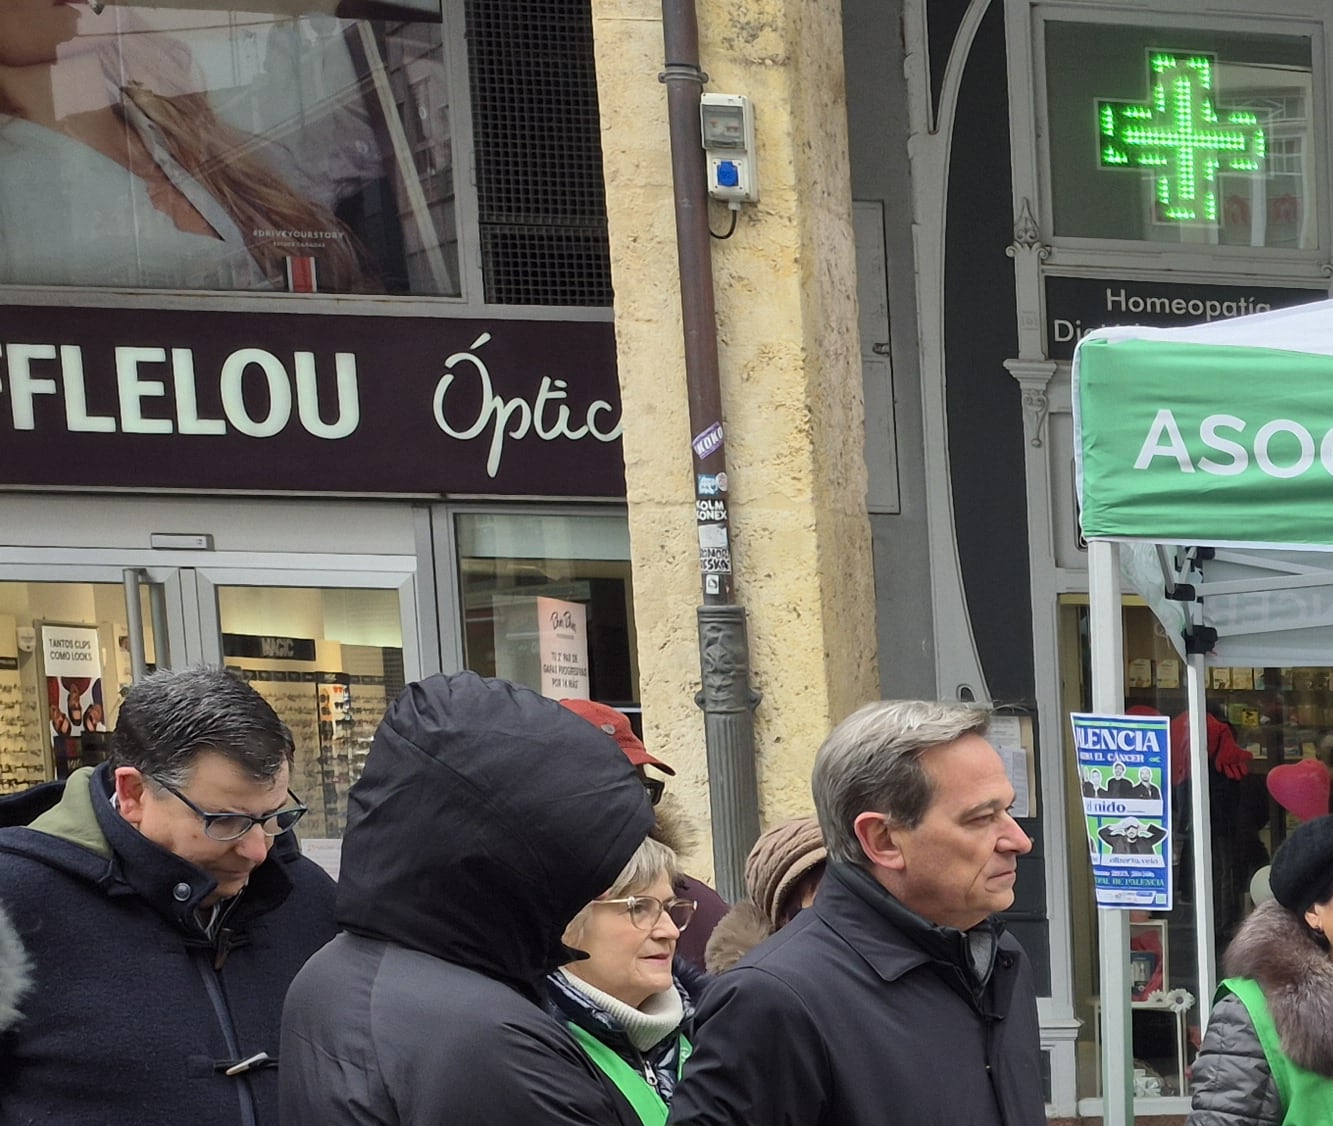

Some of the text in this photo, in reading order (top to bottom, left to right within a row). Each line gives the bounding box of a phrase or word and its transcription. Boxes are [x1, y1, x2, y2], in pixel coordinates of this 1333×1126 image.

[1106, 288, 1271, 321] Homeopatía
[0, 344, 359, 439] FLELOU
[50, 652, 70, 661] COMO
[261, 637, 295, 657] MAGIC
[1076, 727, 1160, 752] LENCIA
[1107, 752, 1144, 763] CÁNCER
[1095, 802, 1126, 813] nido
